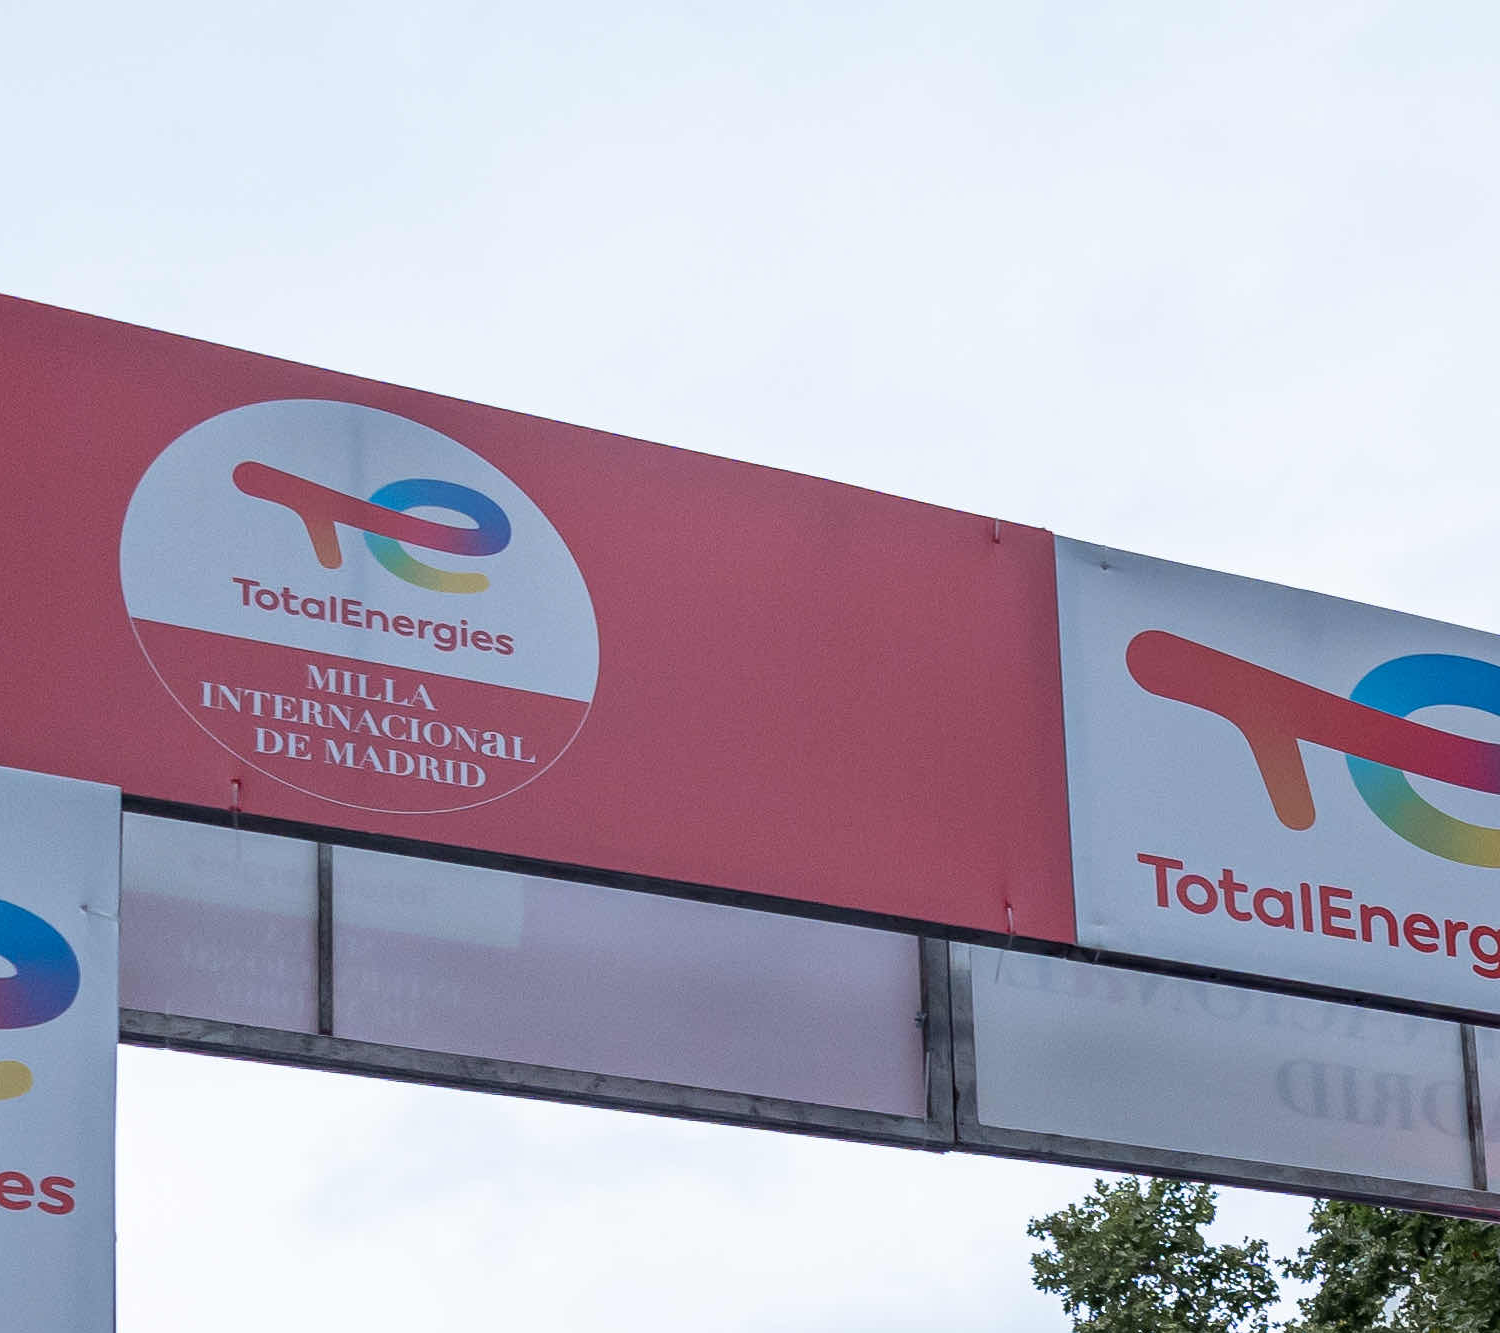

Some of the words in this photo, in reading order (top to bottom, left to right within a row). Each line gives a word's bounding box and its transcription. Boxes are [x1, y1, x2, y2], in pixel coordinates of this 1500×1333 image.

[232, 576, 516, 657] TotalEnergies
[306, 663, 438, 712] MILLA
[255, 727, 313, 762] DE
[323, 738, 488, 789] MADRID
